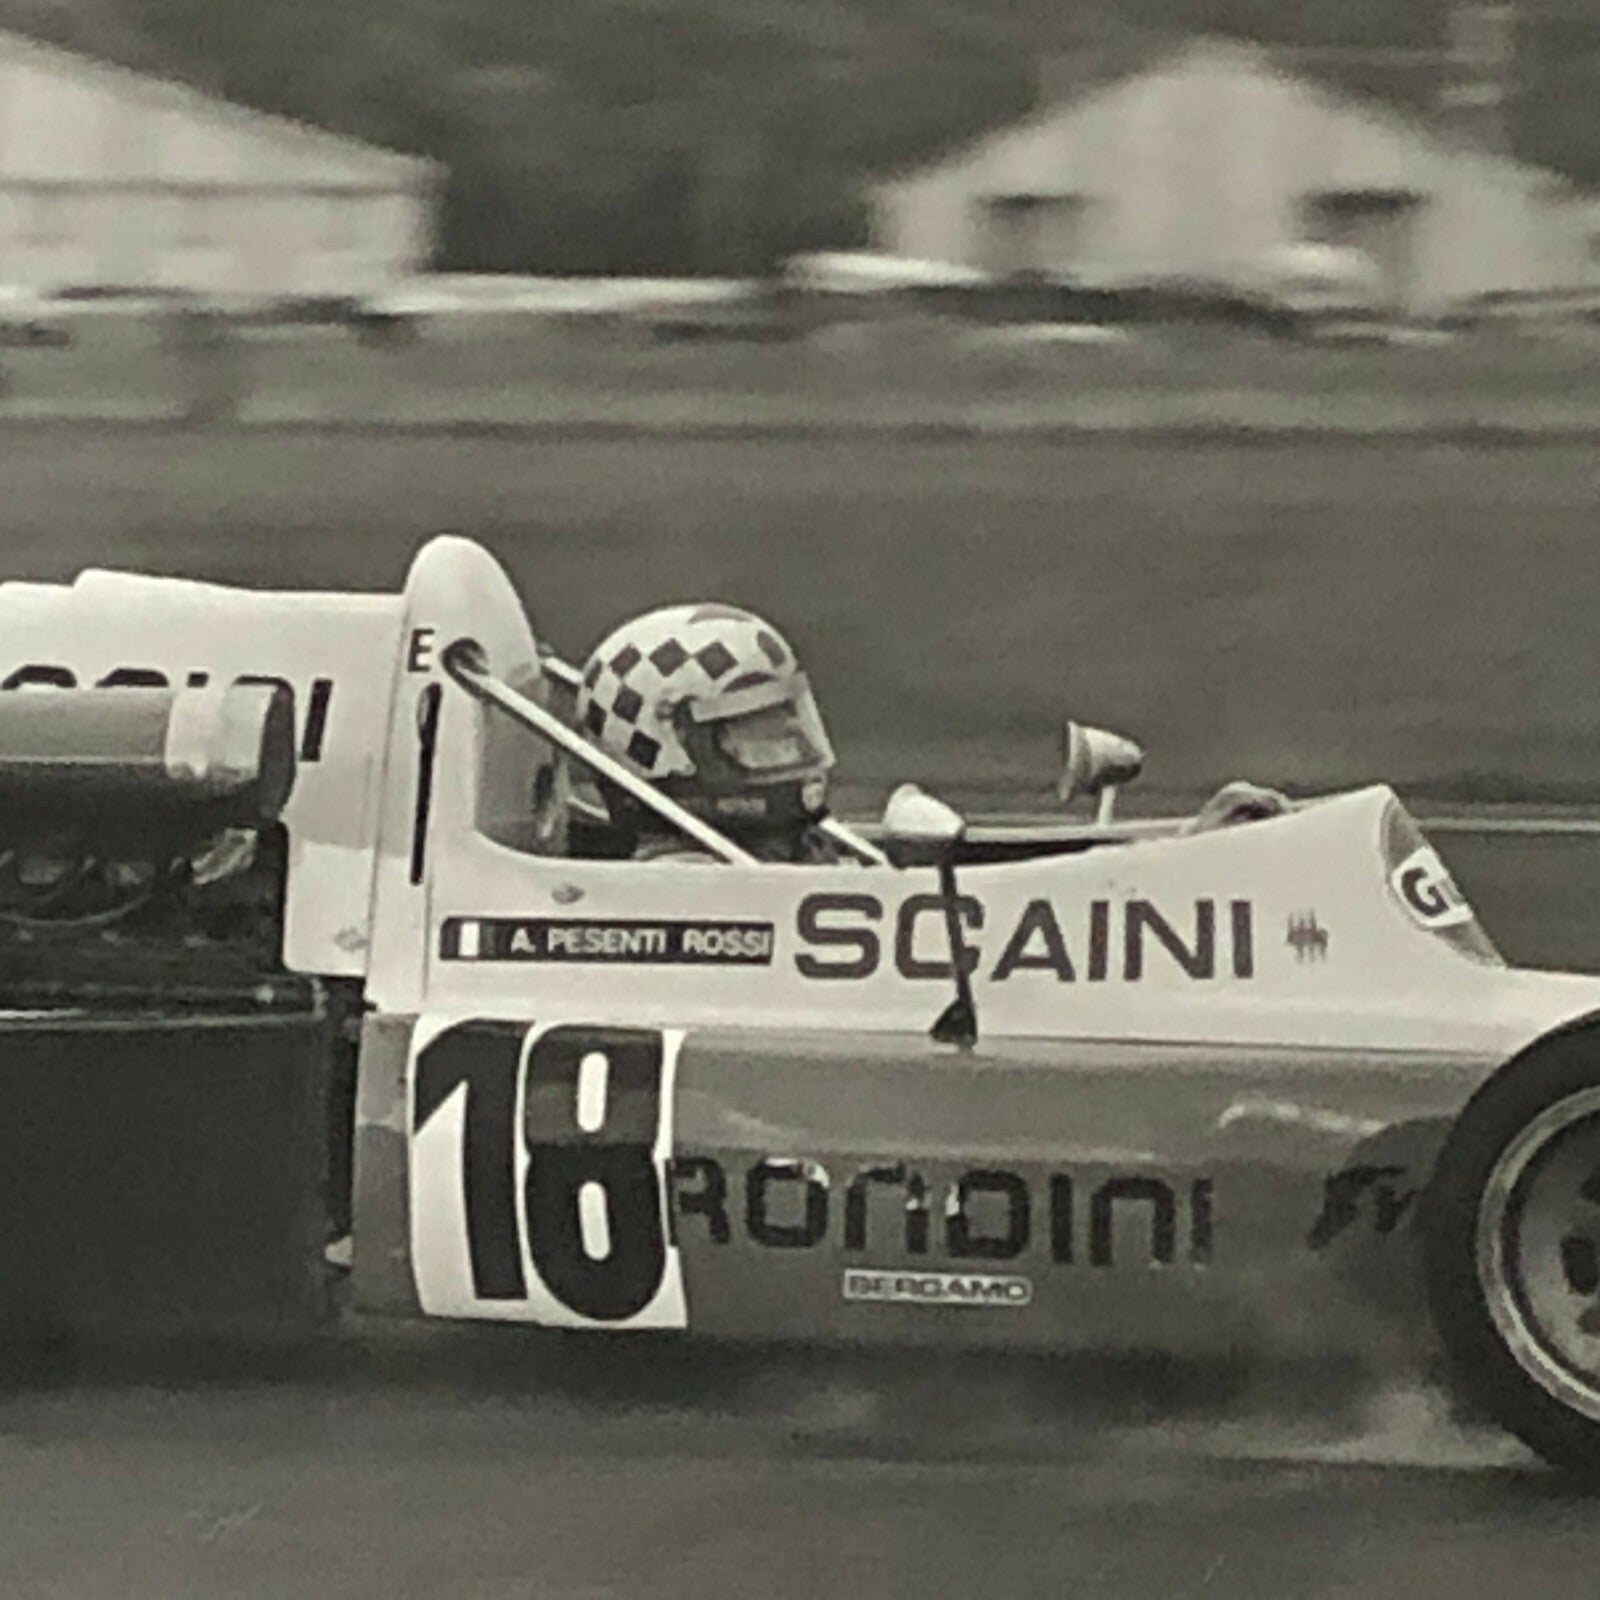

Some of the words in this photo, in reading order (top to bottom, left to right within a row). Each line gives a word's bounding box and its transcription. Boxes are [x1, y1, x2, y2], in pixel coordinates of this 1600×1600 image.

[511, 927, 535, 952] A.
[548, 928, 666, 953] PESENTI
[682, 930, 770, 955] ROSSI
[795, 893, 1254, 982] SCAINI
[414, 1018, 665, 1320] 18
[848, 1275, 1027, 1299] BERGAMO
